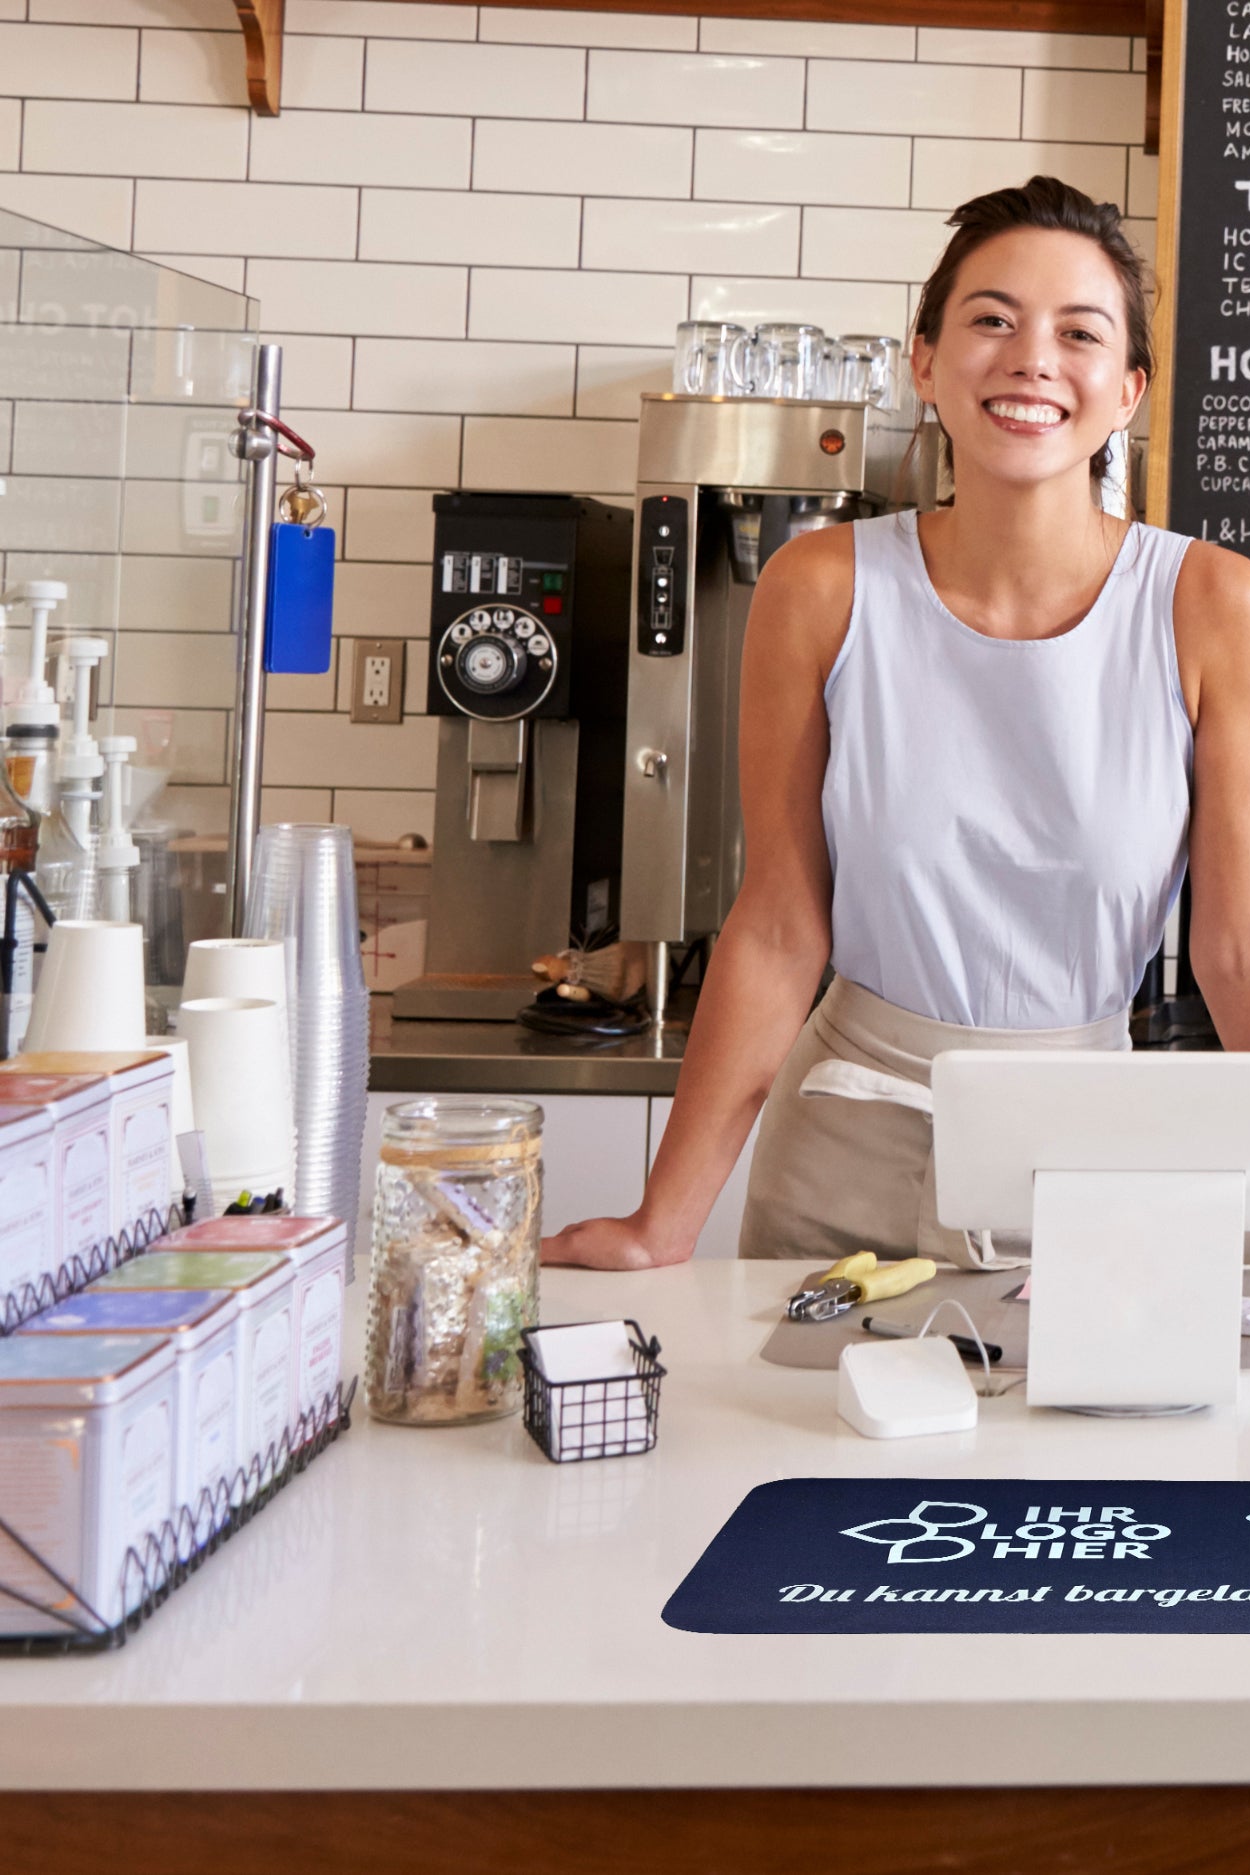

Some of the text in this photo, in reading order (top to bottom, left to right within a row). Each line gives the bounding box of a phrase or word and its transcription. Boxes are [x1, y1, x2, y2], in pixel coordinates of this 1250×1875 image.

[1197, 454, 1231, 471] P.B.
[1024, 1506, 1138, 1522] IHR
[980, 1524, 1171, 1540] LOGO
[992, 1542, 1154, 1559] HIER
[778, 1583, 857, 1602] Du
[864, 1585, 1054, 1602] kannst
